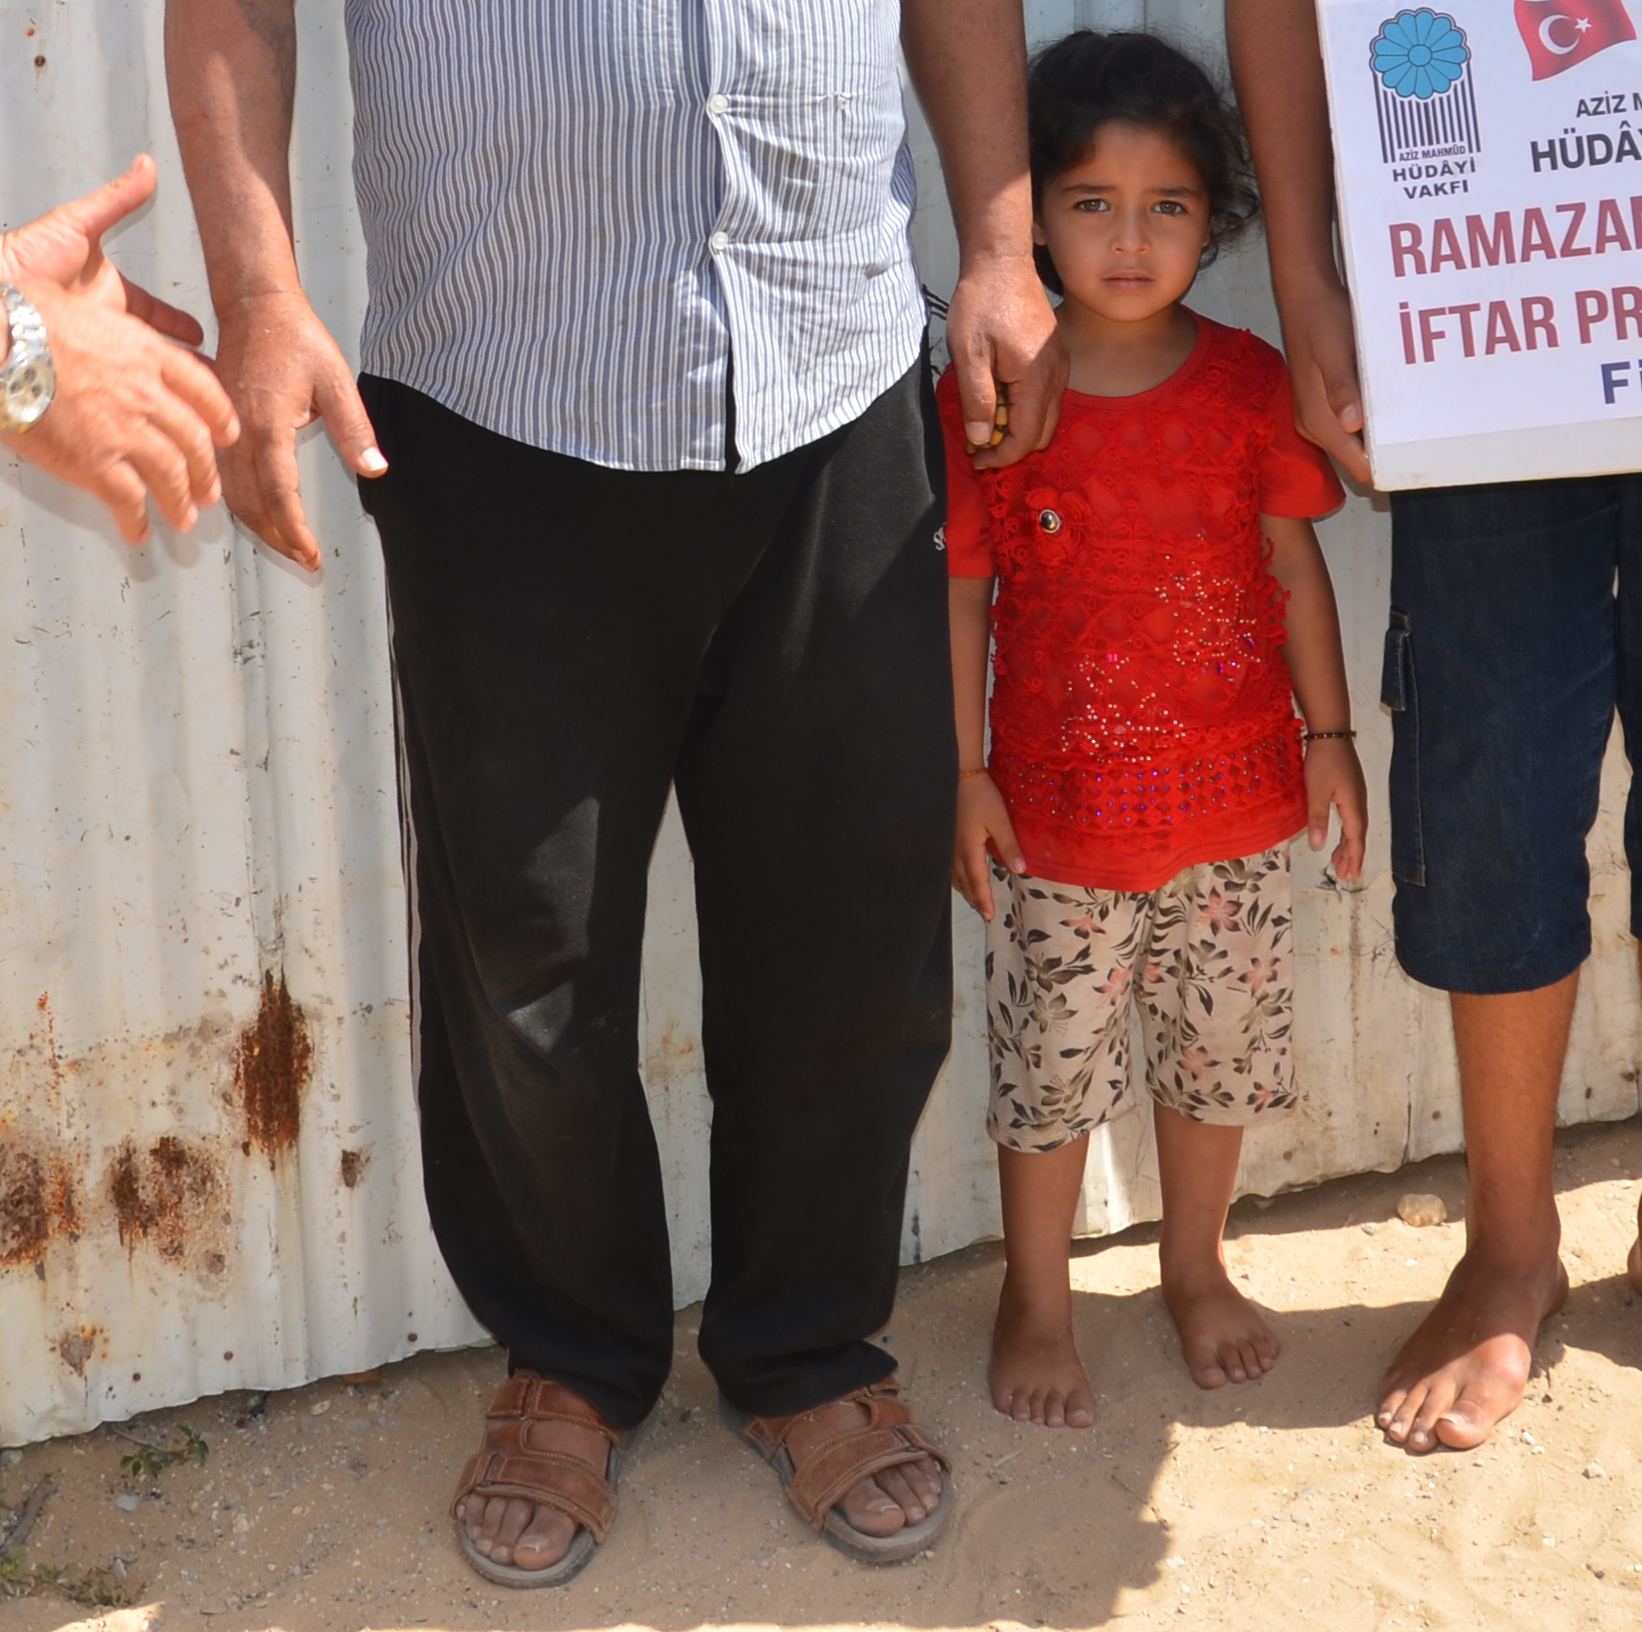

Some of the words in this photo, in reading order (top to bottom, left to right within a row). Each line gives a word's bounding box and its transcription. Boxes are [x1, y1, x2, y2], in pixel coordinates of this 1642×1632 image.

[1575, 90, 1627, 118] AZİZ
[1399, 148, 1419, 162] AZİZ
[1392, 156, 1476, 182] HÜDÂYİ
[1403, 179, 1469, 199] VAKFI
[1398, 295, 1559, 365] İFTAR
